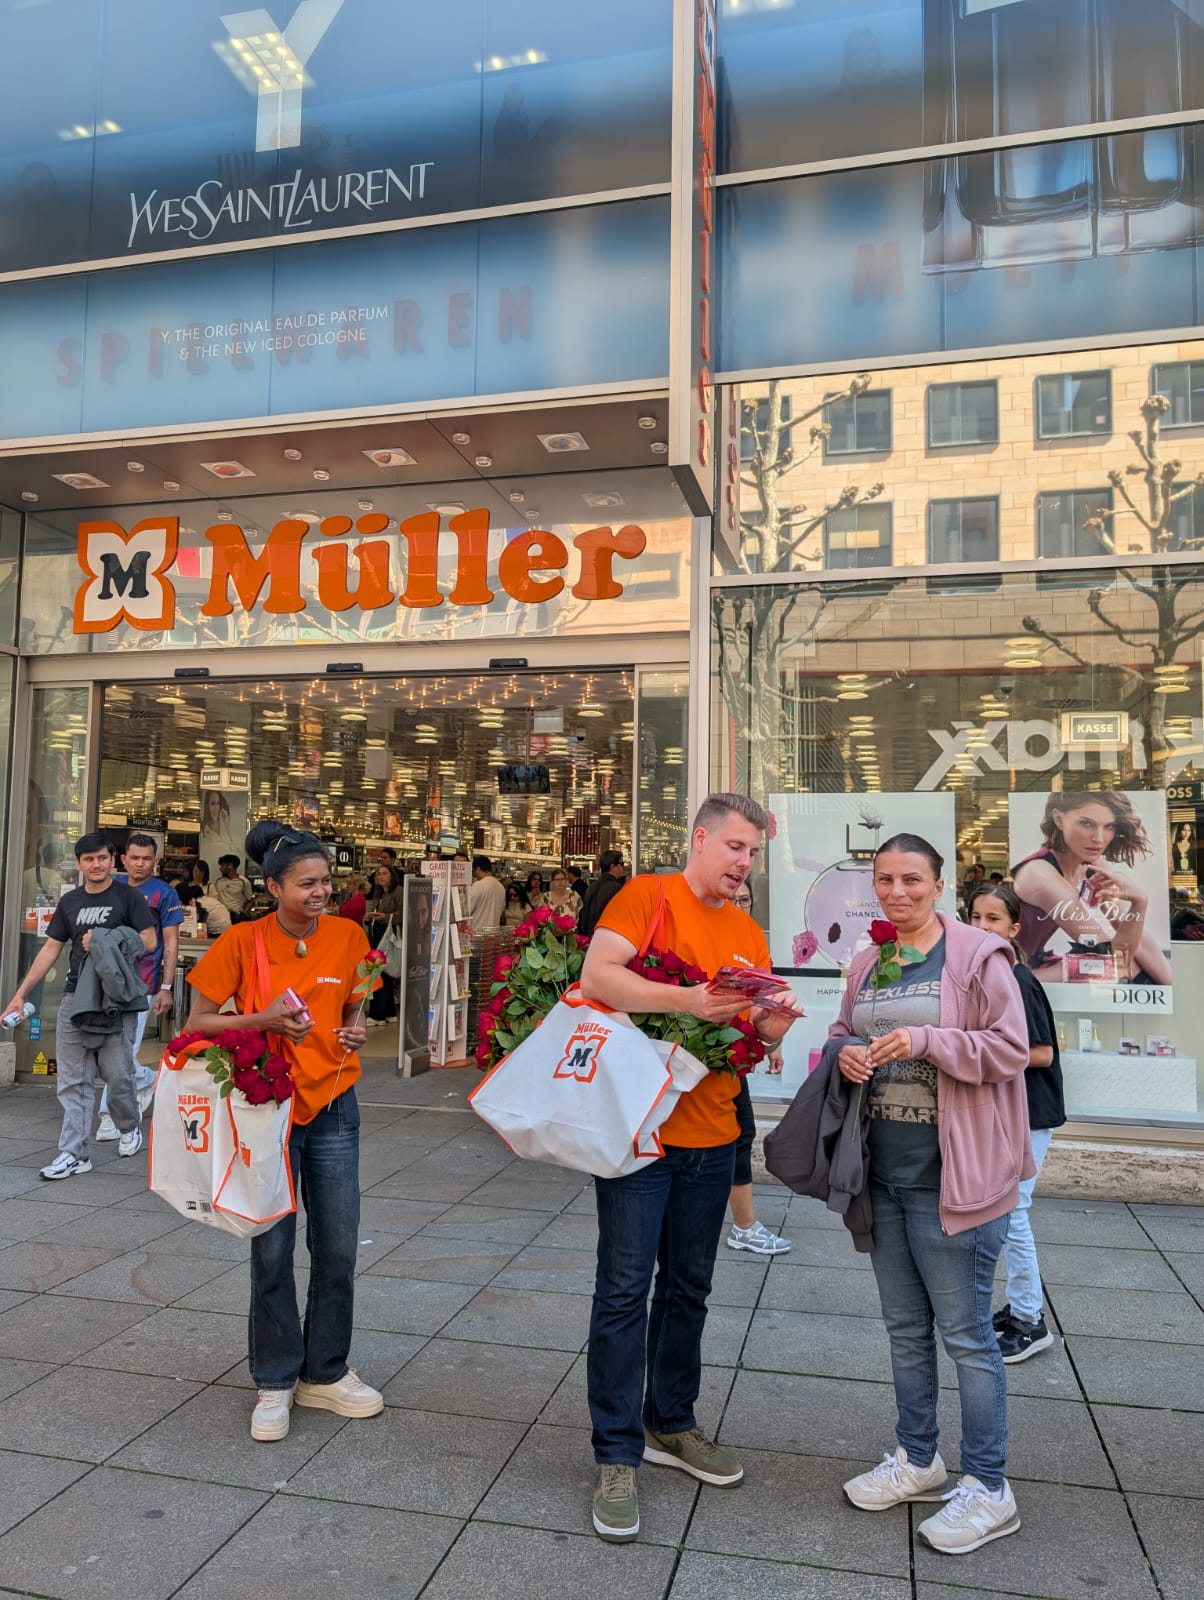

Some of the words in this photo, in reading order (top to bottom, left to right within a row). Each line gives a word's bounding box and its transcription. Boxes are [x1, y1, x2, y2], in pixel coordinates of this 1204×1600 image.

[175, 328, 200, 342] THE
[204, 320, 271, 340] ORIGINAL
[276, 315, 303, 331] EAU
[307, 312, 325, 327] DE
[330, 305, 389, 323] PARFUM
[55, 284, 535, 388] SPIELWAREN
[179, 348, 189, 361] &
[194, 343, 219, 358] THE
[225, 340, 257, 356] NEW
[261, 336, 293, 351] ICED
[297, 328, 367, 347] COLOGNE
[98, 551, 151, 600] M
[200, 507, 647, 617] Müller
[1077, 723, 1114, 733] KASSE
[203, 774, 220, 782] KASSE
[230, 775, 247, 784] KASSE
[1166, 786, 1193, 799] OSS
[76, 906, 114, 926] NIKE
[1037, 900, 1092, 921] Miss
[1099, 900, 1142, 922] Dior
[1112, 988, 1167, 1005] DIOR
[574, 1022, 613, 1036] Müller
[567, 1047, 594, 1068] M
